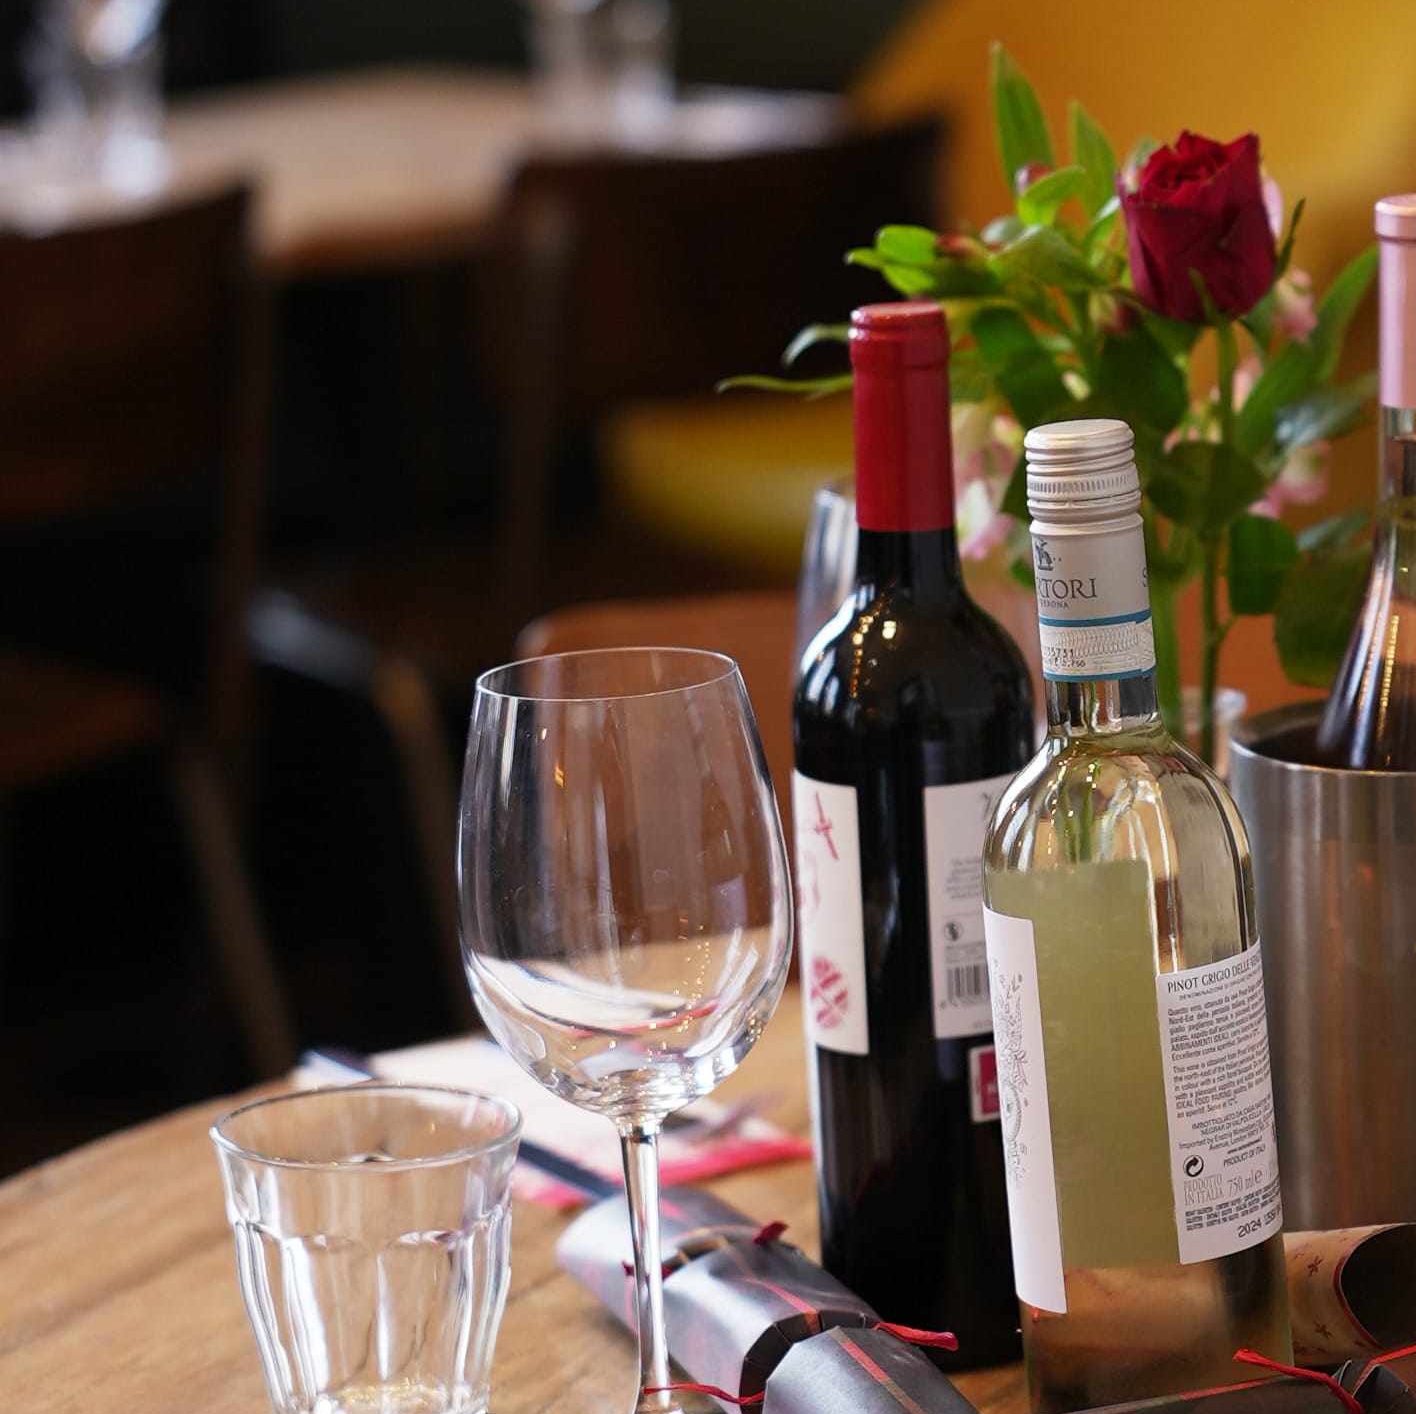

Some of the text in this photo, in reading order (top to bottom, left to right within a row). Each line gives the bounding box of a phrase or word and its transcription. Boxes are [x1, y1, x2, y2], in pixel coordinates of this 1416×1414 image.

[1036, 577, 1097, 599] RTORI
[1041, 599, 1069, 609] ERONA
[1167, 977, 1199, 993] PINOT
[1202, 968, 1231, 985] GRIGIO
[1232, 959, 1250, 977] DELLE
[1223, 1152, 1248, 1167] PRODUCT
[1183, 1174, 1222, 1195] PRODOTTO
[1197, 1183, 1224, 1203] ITALIA
[1227, 1176, 1243, 1196] 750
[1237, 1218, 1262, 1238] 2024
